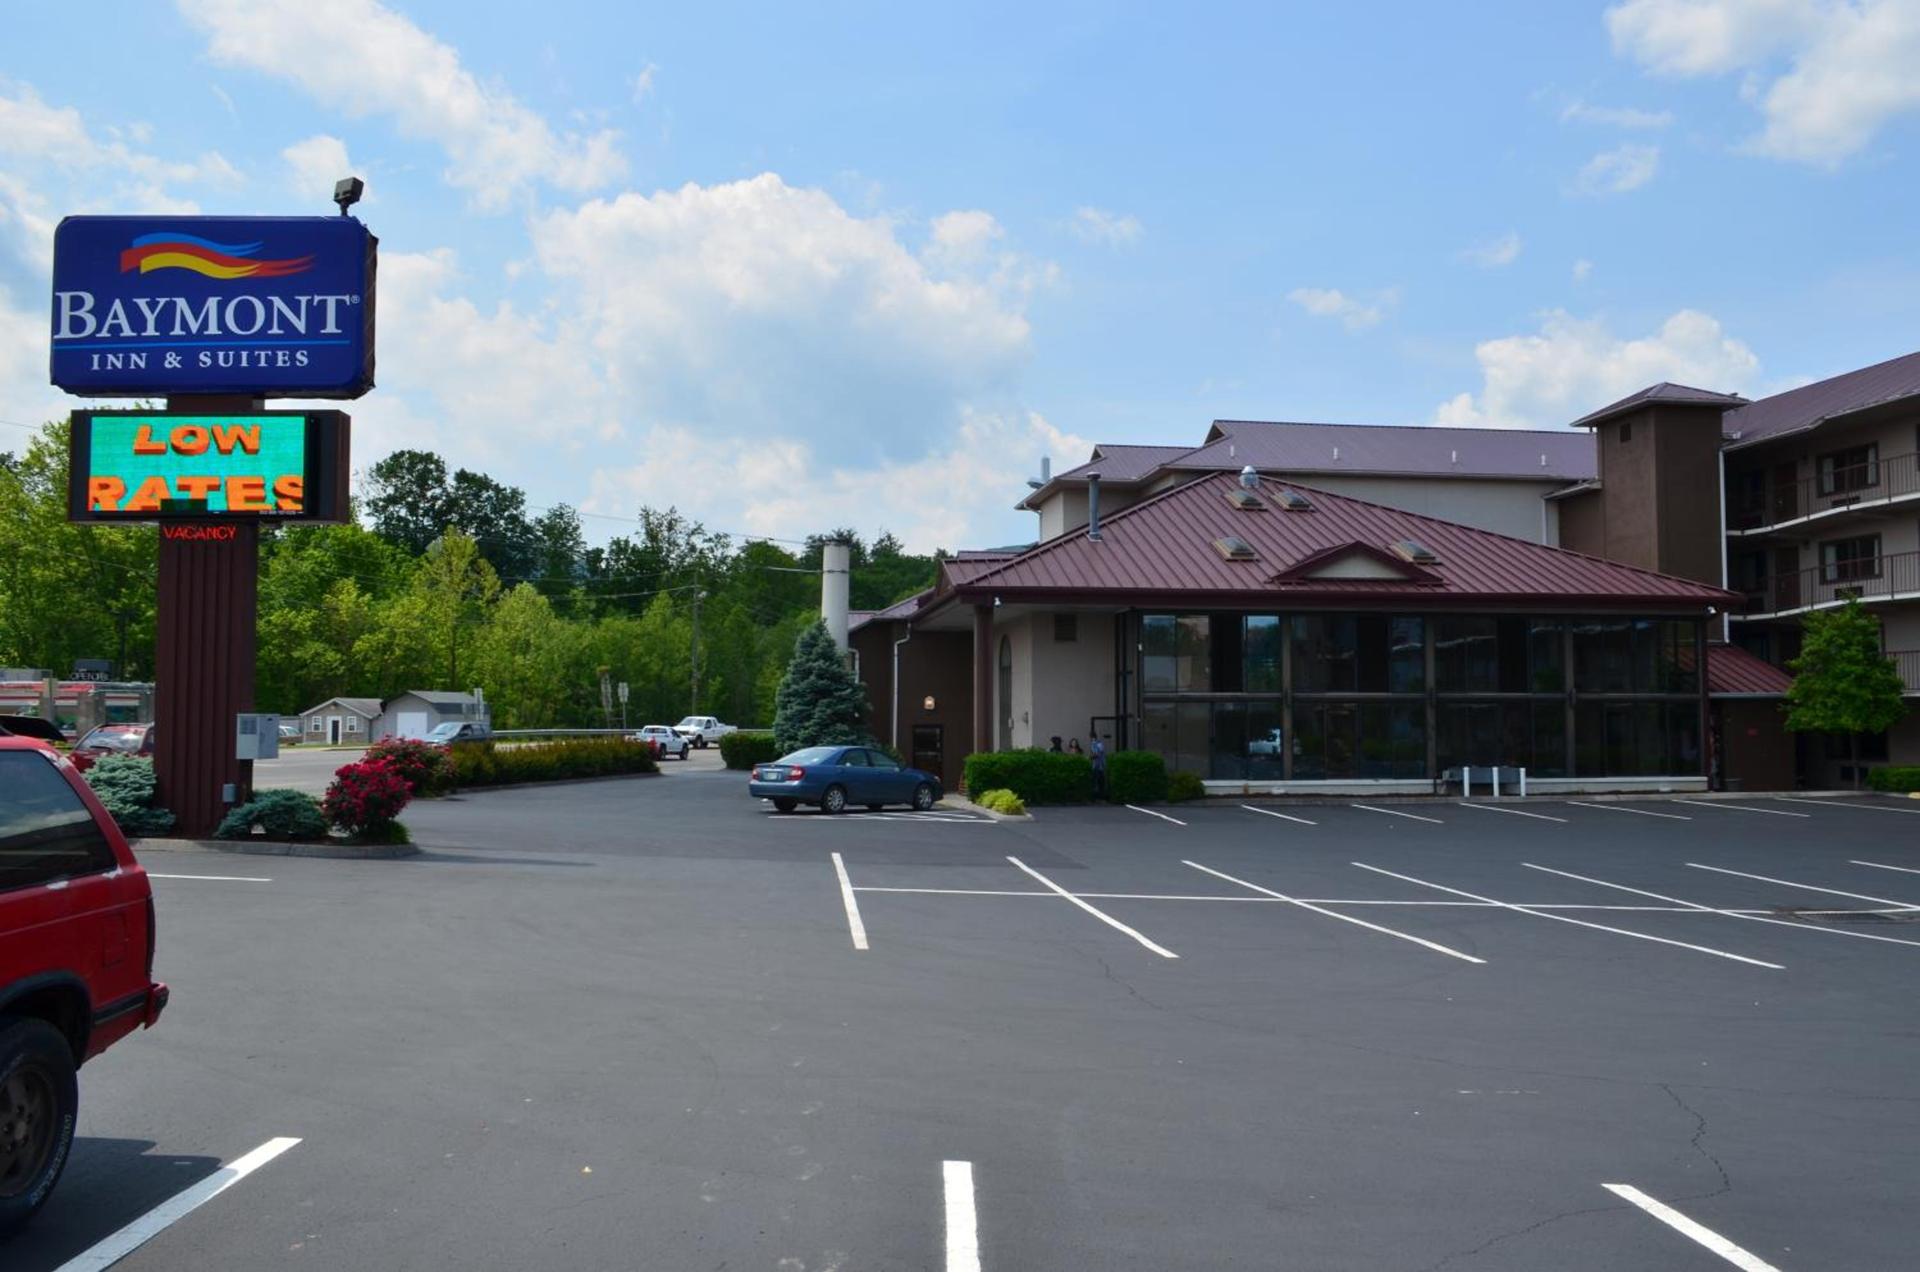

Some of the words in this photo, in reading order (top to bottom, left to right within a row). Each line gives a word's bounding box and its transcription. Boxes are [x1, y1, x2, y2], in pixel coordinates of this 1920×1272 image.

[53, 291, 350, 339] BAYMONT
[91, 352, 147, 370] INN
[164, 351, 183, 369] &
[199, 349, 310, 369] SUITES
[133, 424, 261, 456] LOW
[88, 474, 304, 512] RATES
[163, 525, 237, 541] VACANCY
